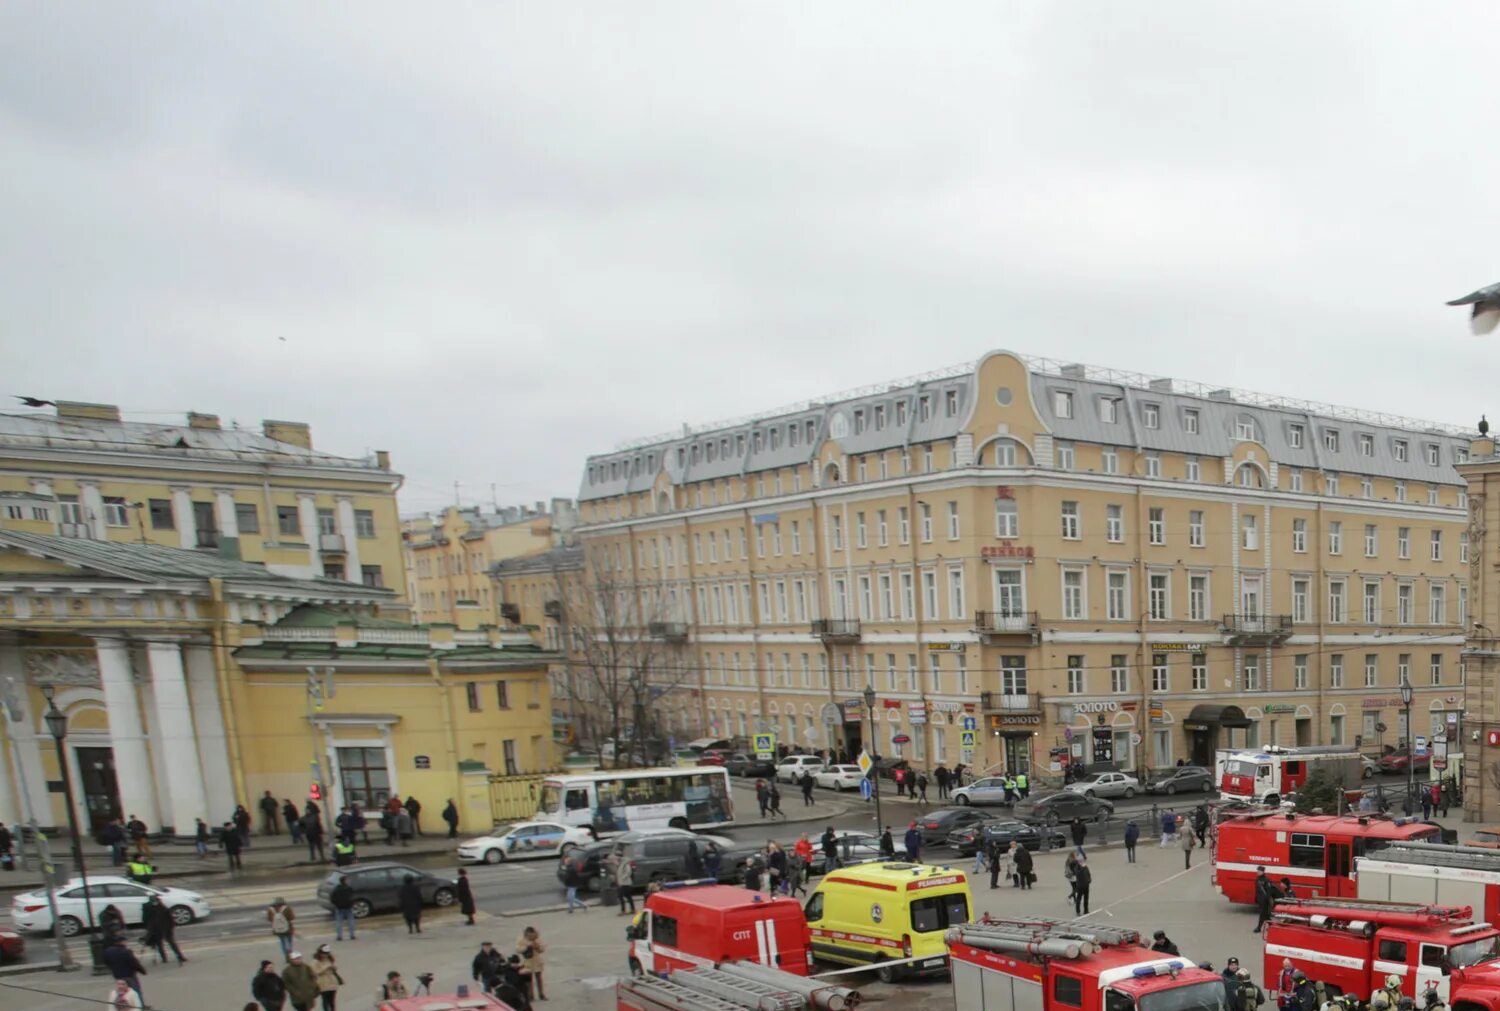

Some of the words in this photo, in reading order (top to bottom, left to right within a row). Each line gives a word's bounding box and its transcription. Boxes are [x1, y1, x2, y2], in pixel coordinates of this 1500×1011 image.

[1073, 701, 1118, 713] ЗОЛОТО
[1002, 715, 1040, 725] ЗОЛОТО
[733, 930, 752, 941] СПТ
[1424, 979, 1441, 991] 17
